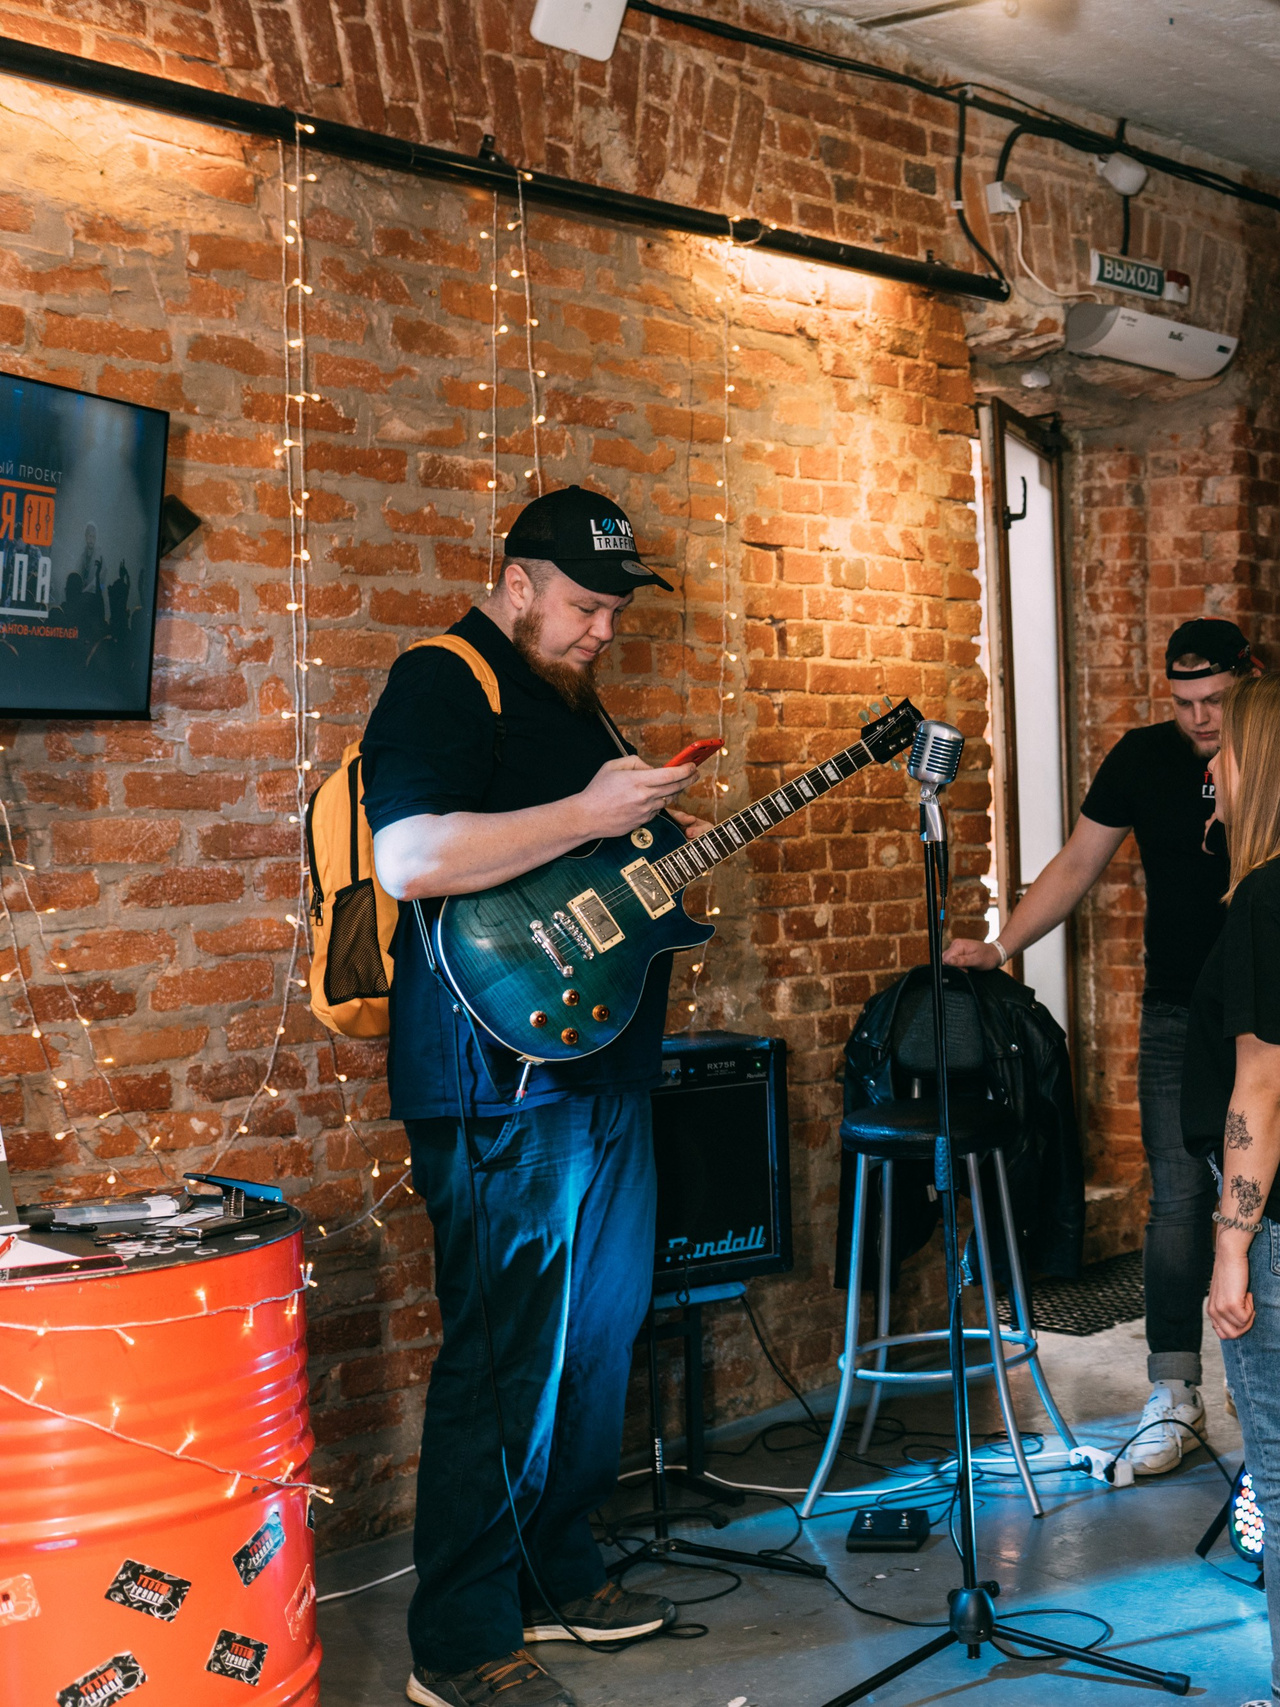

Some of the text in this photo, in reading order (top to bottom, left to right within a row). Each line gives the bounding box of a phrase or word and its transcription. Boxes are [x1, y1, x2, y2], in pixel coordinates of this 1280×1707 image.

[1103, 258, 1159, 292] ВЫХОД
[19, 464, 63, 484] ПРОЕКТ
[590, 518, 634, 538] LOVE
[0, 623, 78, 639] АНТОВ-ЛЮБИТЕЛЕЙ
[707, 1060, 736, 1071] RX75R
